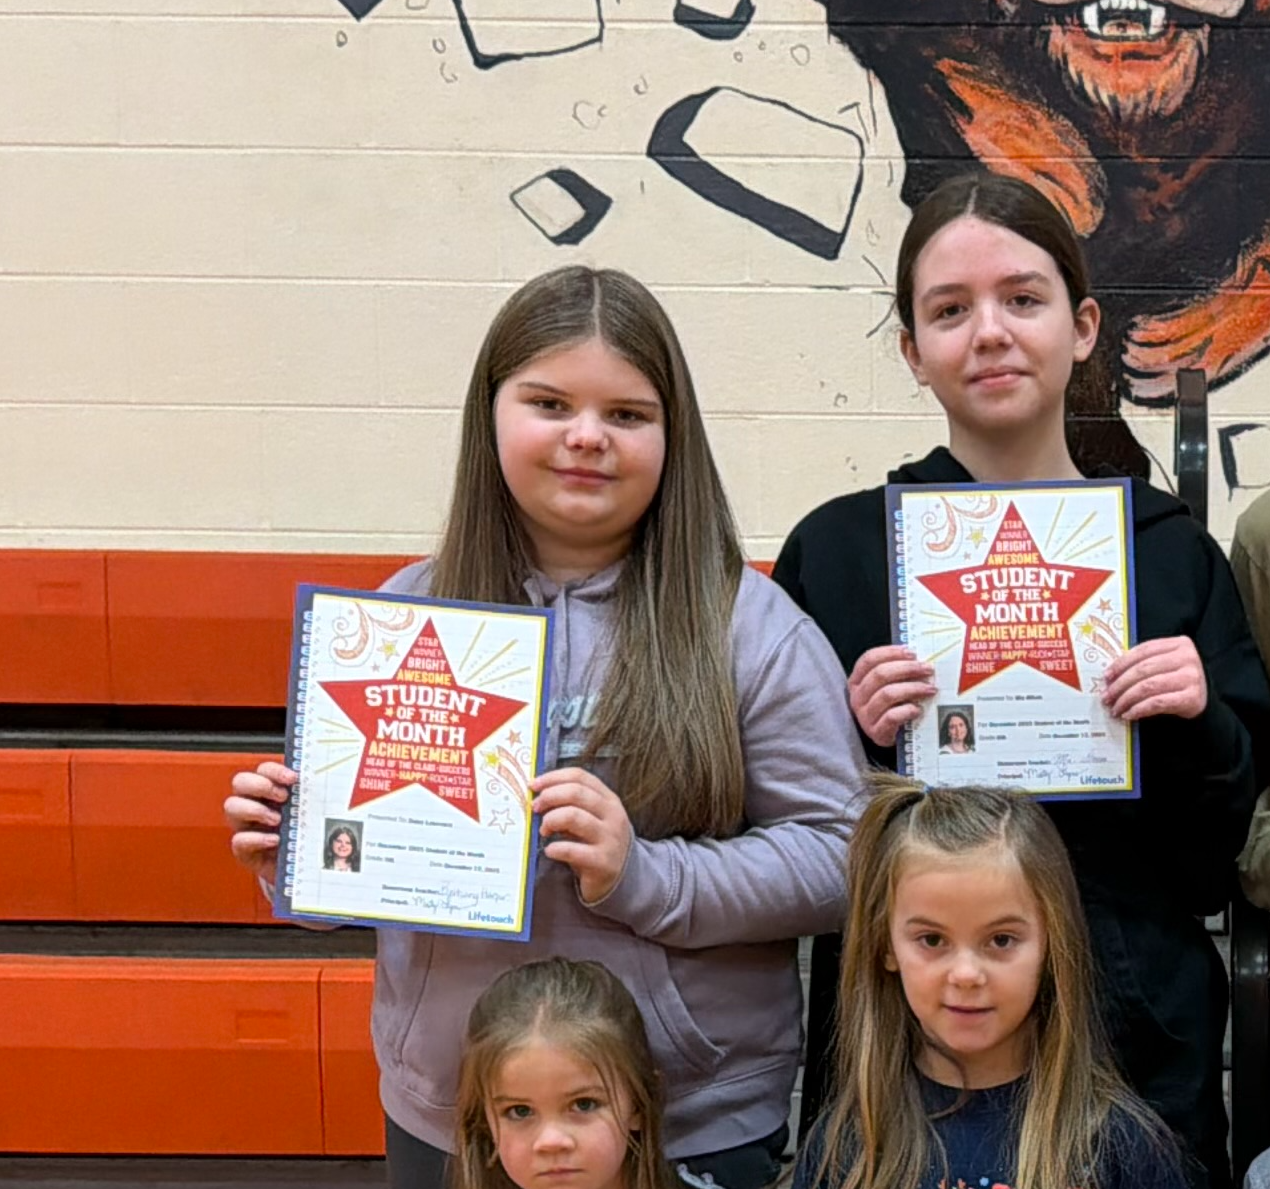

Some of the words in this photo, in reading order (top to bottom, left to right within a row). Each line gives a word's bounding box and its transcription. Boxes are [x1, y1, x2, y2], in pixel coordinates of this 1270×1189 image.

[996, 540, 1032, 551] BRIGHT
[988, 553, 1039, 565] AWESOME
[960, 566, 1074, 593] STUDENT
[991, 589, 1008, 601] OF
[1011, 588, 1041, 601] THE
[975, 602, 1058, 623] MONTH
[970, 623, 1063, 640] ACHIEVEMENT
[407, 656, 446, 671] BRIGHT
[1038, 659, 1072, 669] SWEET
[396, 669, 451, 685] AWESOME
[365, 684, 486, 716] STUDENT
[395, 706, 415, 719] OF
[418, 708, 448, 723] THE
[376, 718, 465, 746] MONTH
[368, 740, 468, 764] ACHIEVEMENT
[1081, 774, 1124, 785] Lifetouch
[437, 785, 474, 799] SWEET
[468, 911, 515, 924] Lifetouch
